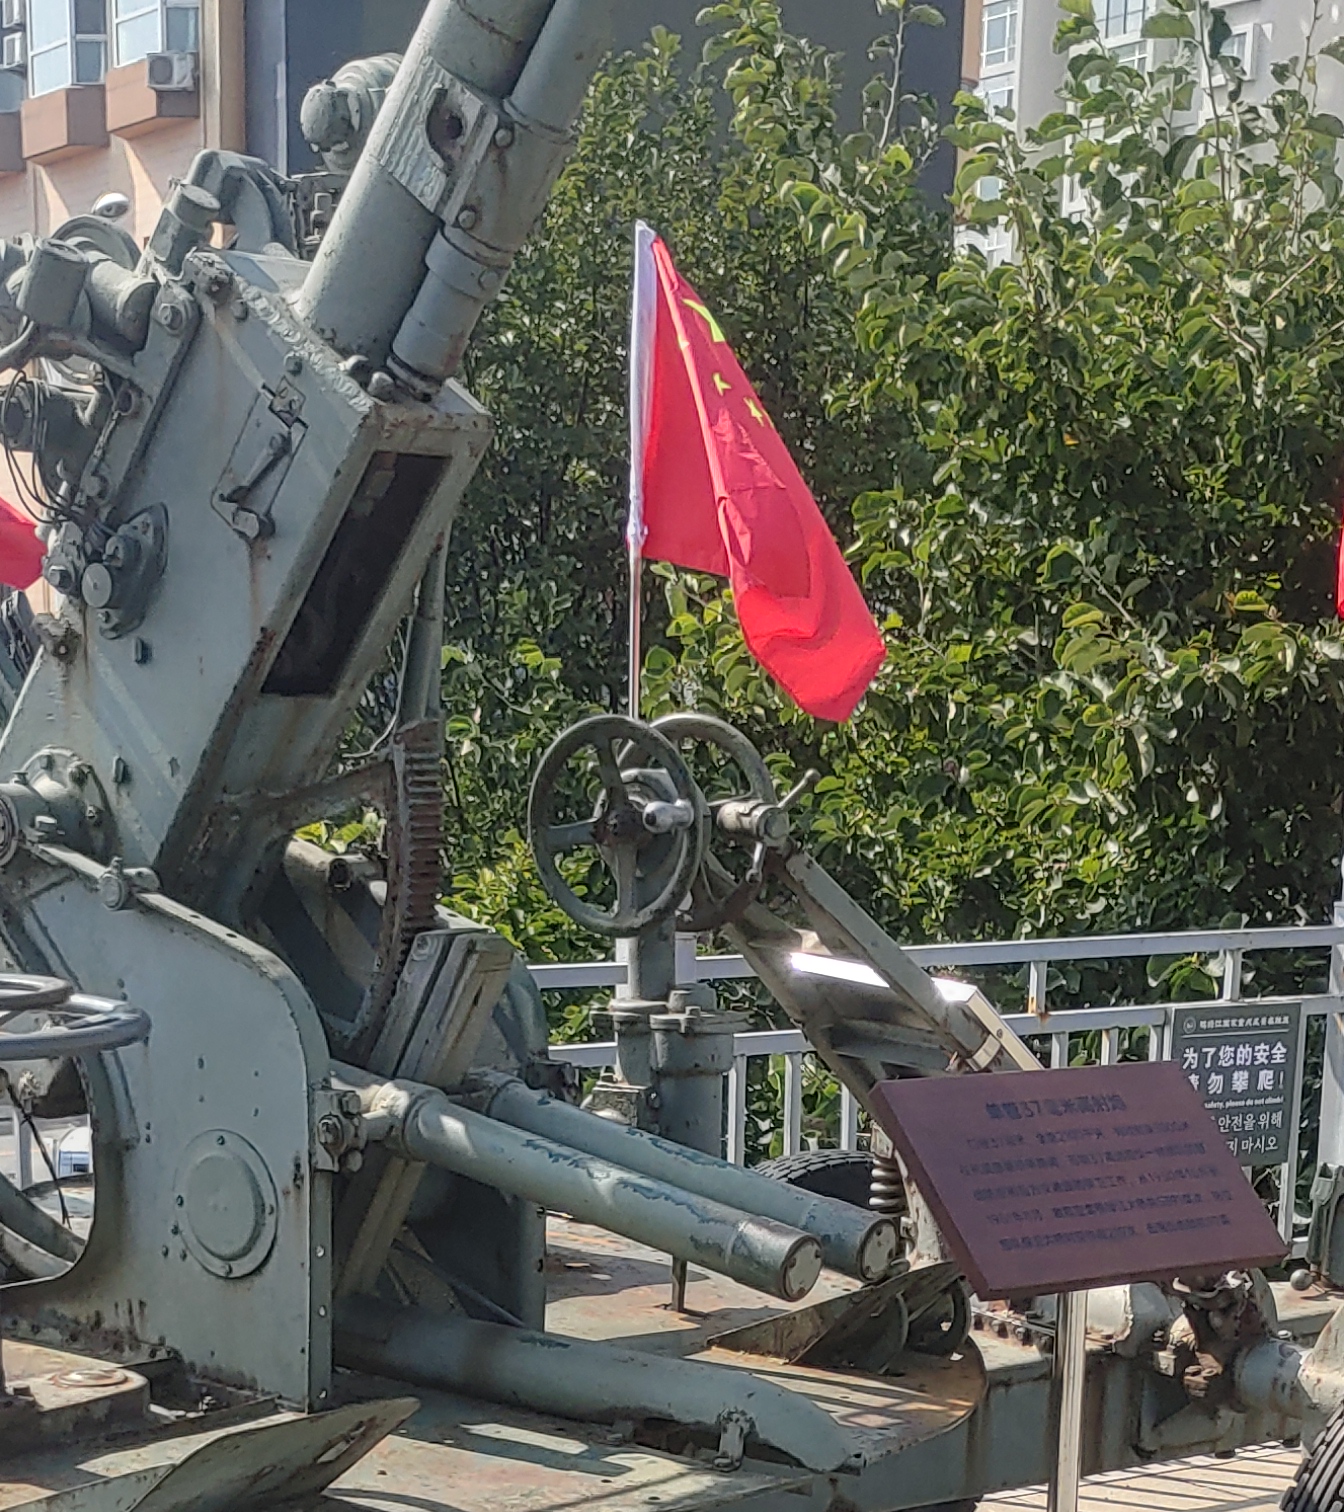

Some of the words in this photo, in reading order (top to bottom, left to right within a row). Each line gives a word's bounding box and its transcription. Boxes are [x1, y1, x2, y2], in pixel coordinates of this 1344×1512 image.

[1182, 1041, 1287, 1070] 为了您的安全
[1218, 1113, 1256, 1133] 안전을
[1241, 1134, 1278, 1154] 마시오
